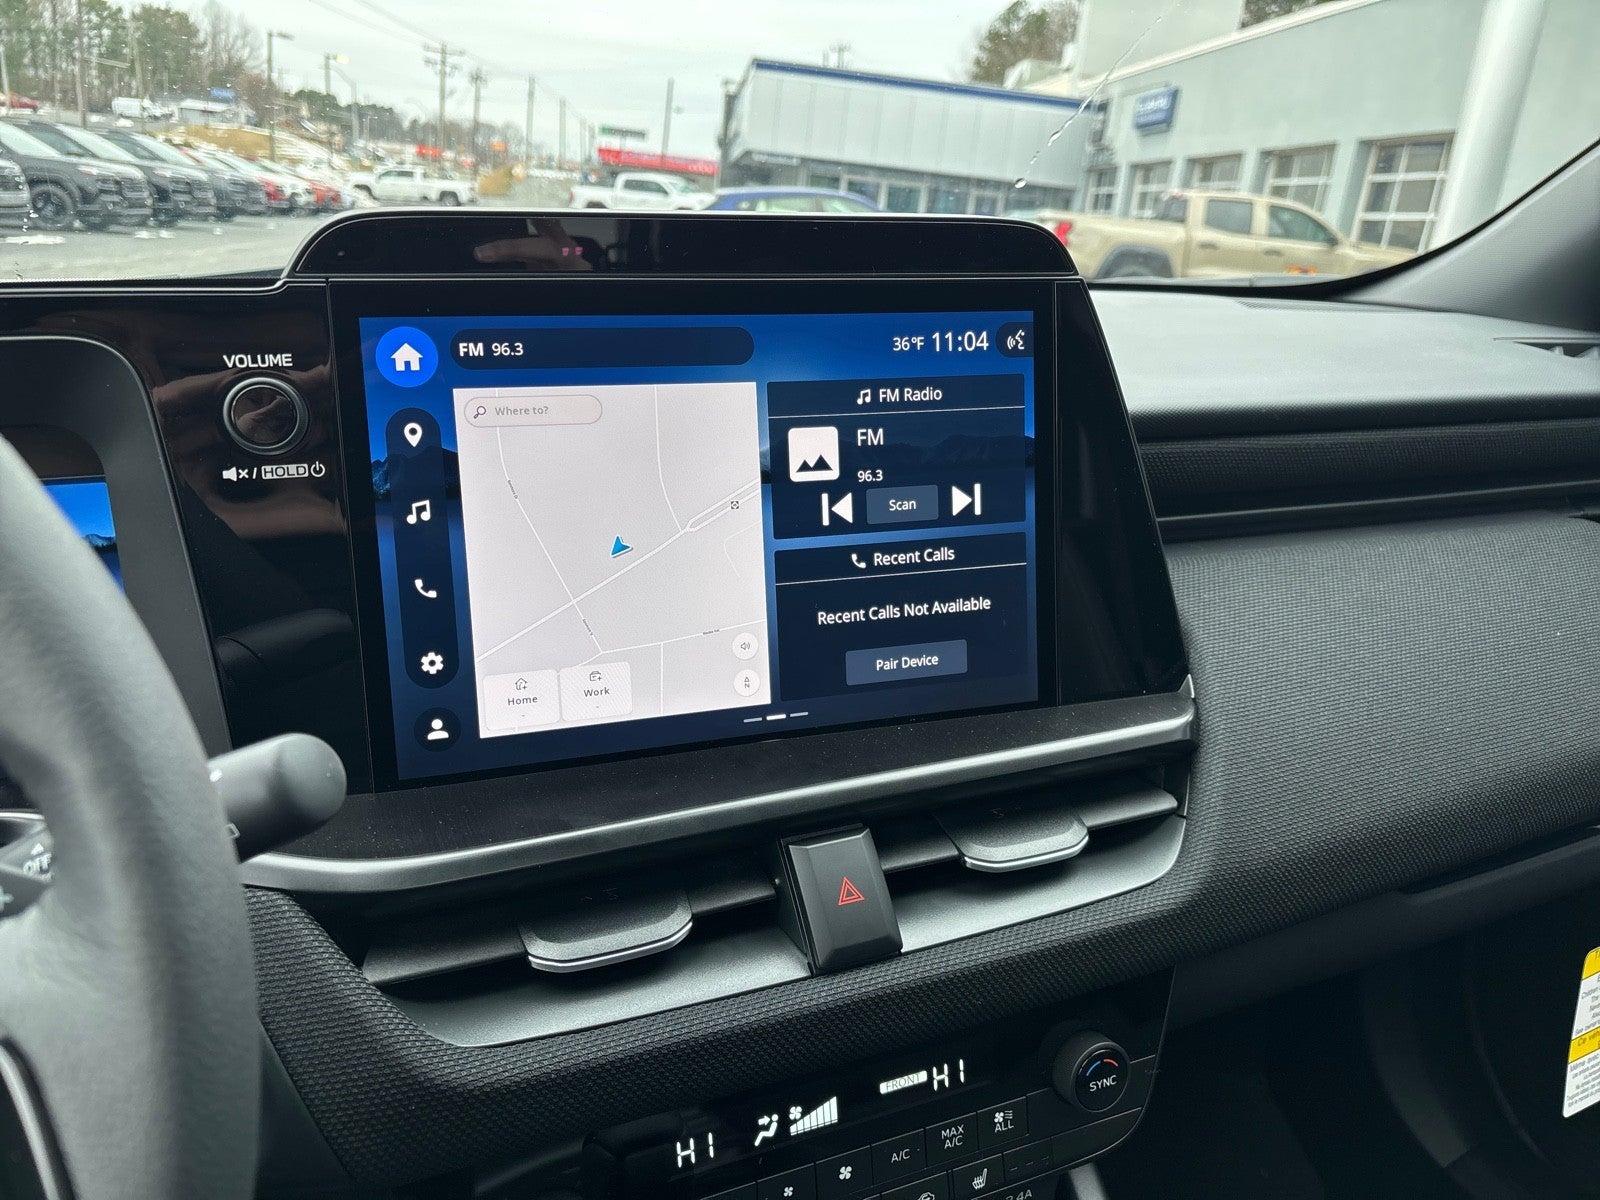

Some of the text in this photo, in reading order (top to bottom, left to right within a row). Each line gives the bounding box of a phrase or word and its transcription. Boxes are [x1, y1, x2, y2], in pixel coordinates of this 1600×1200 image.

[892, 330, 989, 352] 36°F 11:04
[458, 342, 524, 357] FM 96.3
[223, 353, 293, 368] VOLUME
[878, 386, 943, 402] FM Radio
[494, 405, 549, 416] Where to?
[857, 428, 884, 446] FM
[262, 464, 308, 479] HOLD
[857, 469, 883, 482] 96.3
[888, 498, 917, 511] Scan
[873, 547, 955, 566] Recent Calls
[817, 596, 992, 625] Recent Calls Not Available
[876, 654, 939, 671] Pair Device
[583, 686, 610, 697] Work
[507, 696, 538, 706] Home
[885, 1073, 921, 1092] FRONT
[1089, 1074, 1118, 1092] SYNC
[941, 1124, 965, 1140] MAX
[994, 1120, 1014, 1133] ALL
[944, 1135, 964, 1149] A/C
[891, 1148, 911, 1163] A/C
